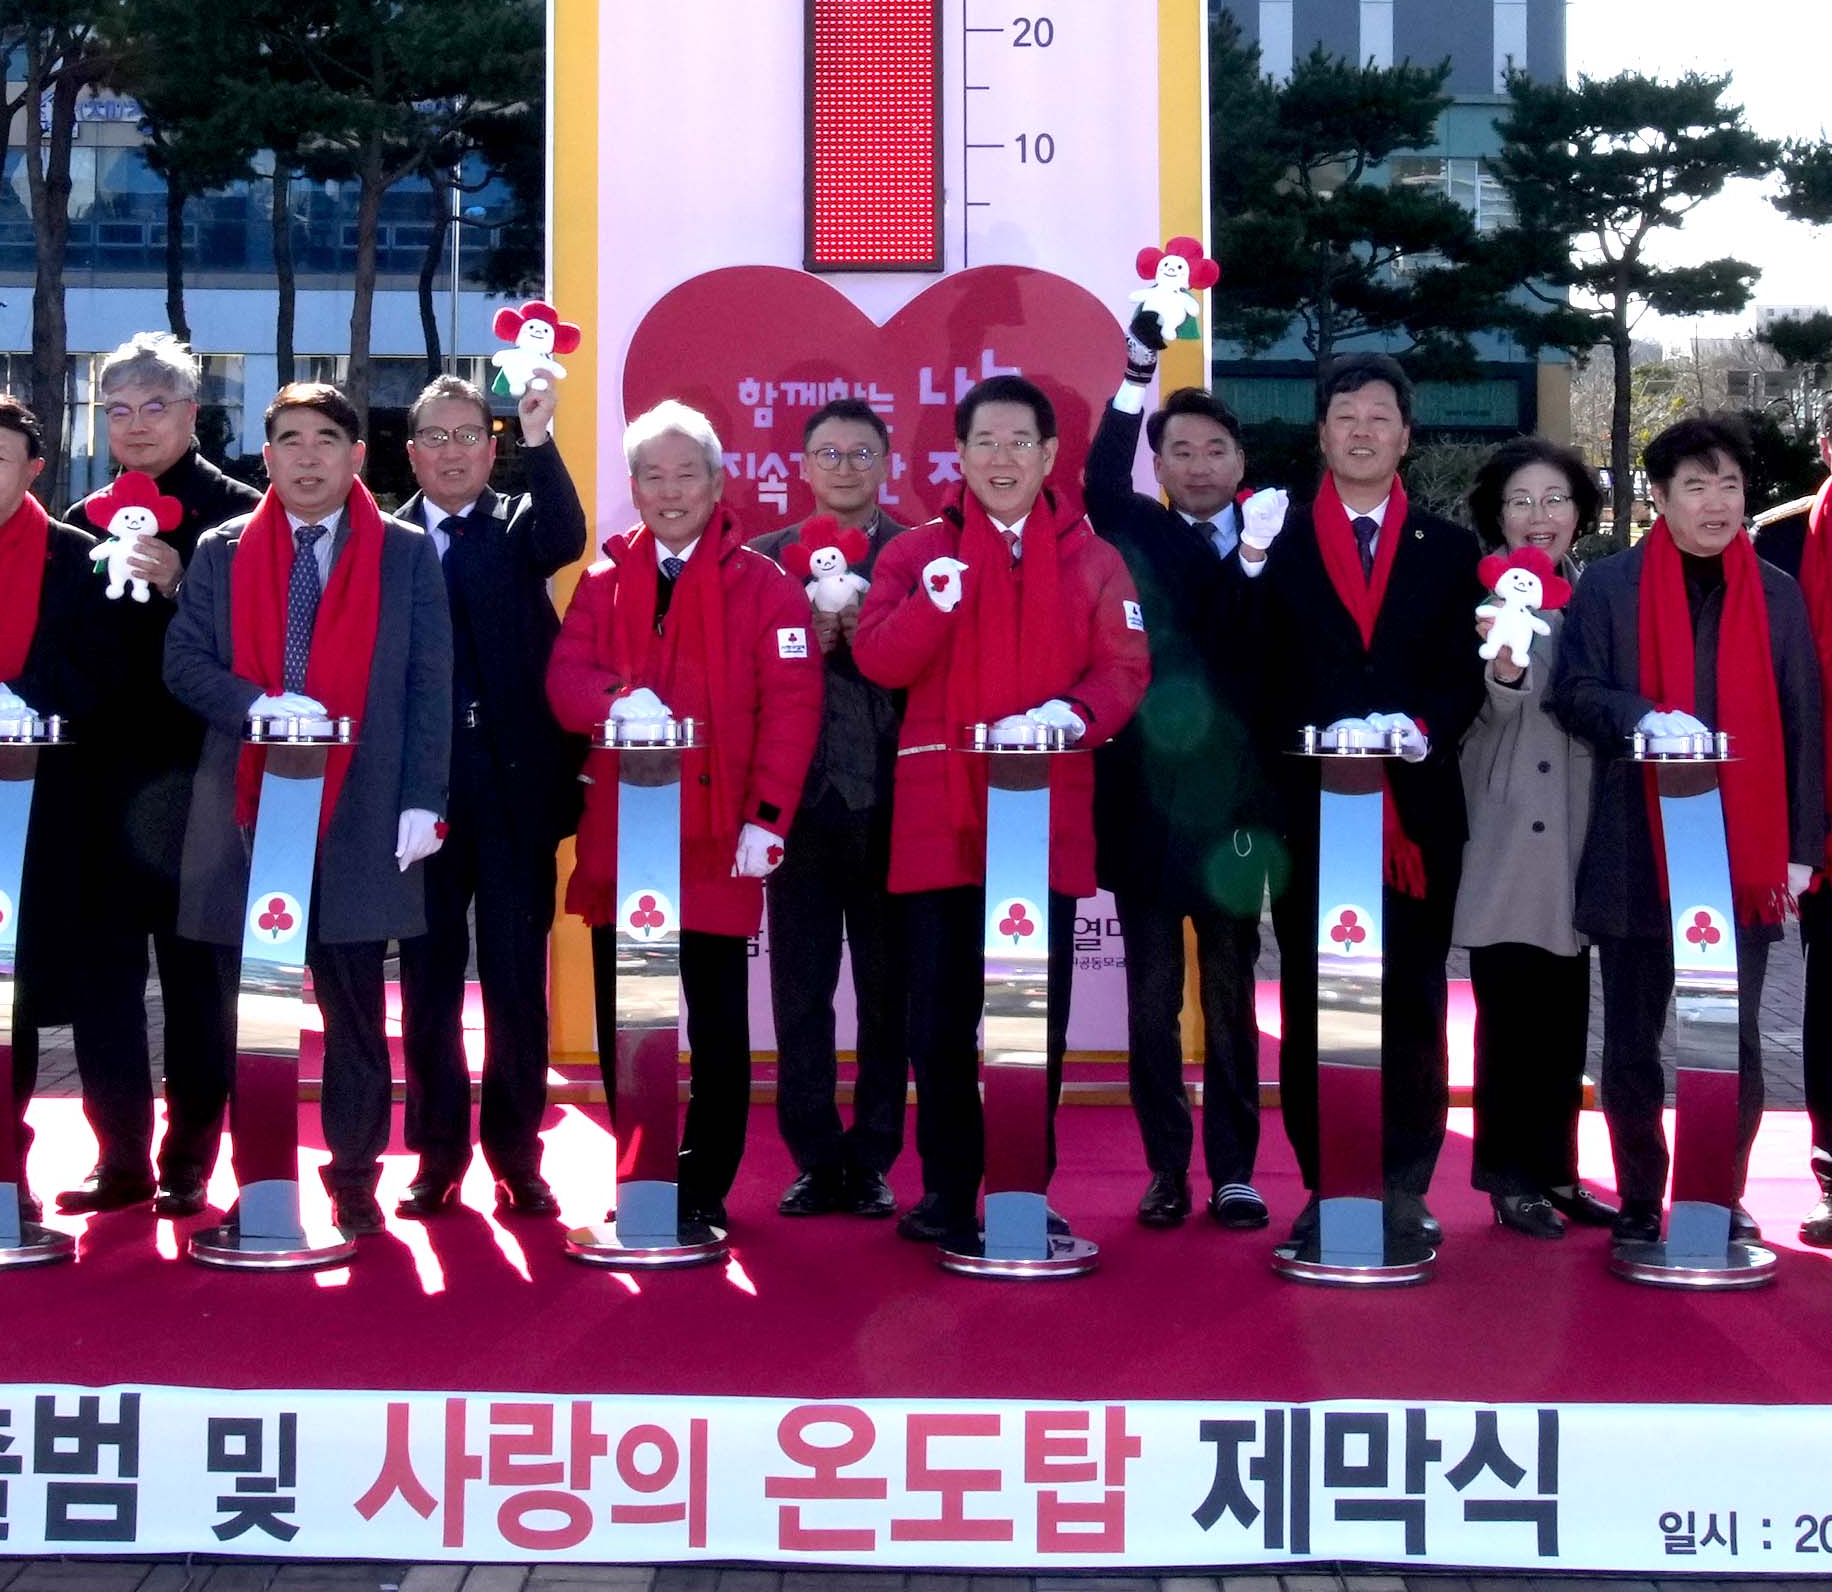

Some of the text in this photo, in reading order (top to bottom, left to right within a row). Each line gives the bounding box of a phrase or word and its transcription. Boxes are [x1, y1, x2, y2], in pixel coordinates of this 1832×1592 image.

[1013, 17, 1055, 49] 20
[1015, 133, 1056, 165] 10
[205, 1412, 302, 1544] 및
[353, 1397, 709, 1551] 사랑의
[765, 1404, 1142, 1555] 온도탑
[1191, 1407, 1560, 1558] 제막식
[1659, 1511, 1740, 1557] 일시
